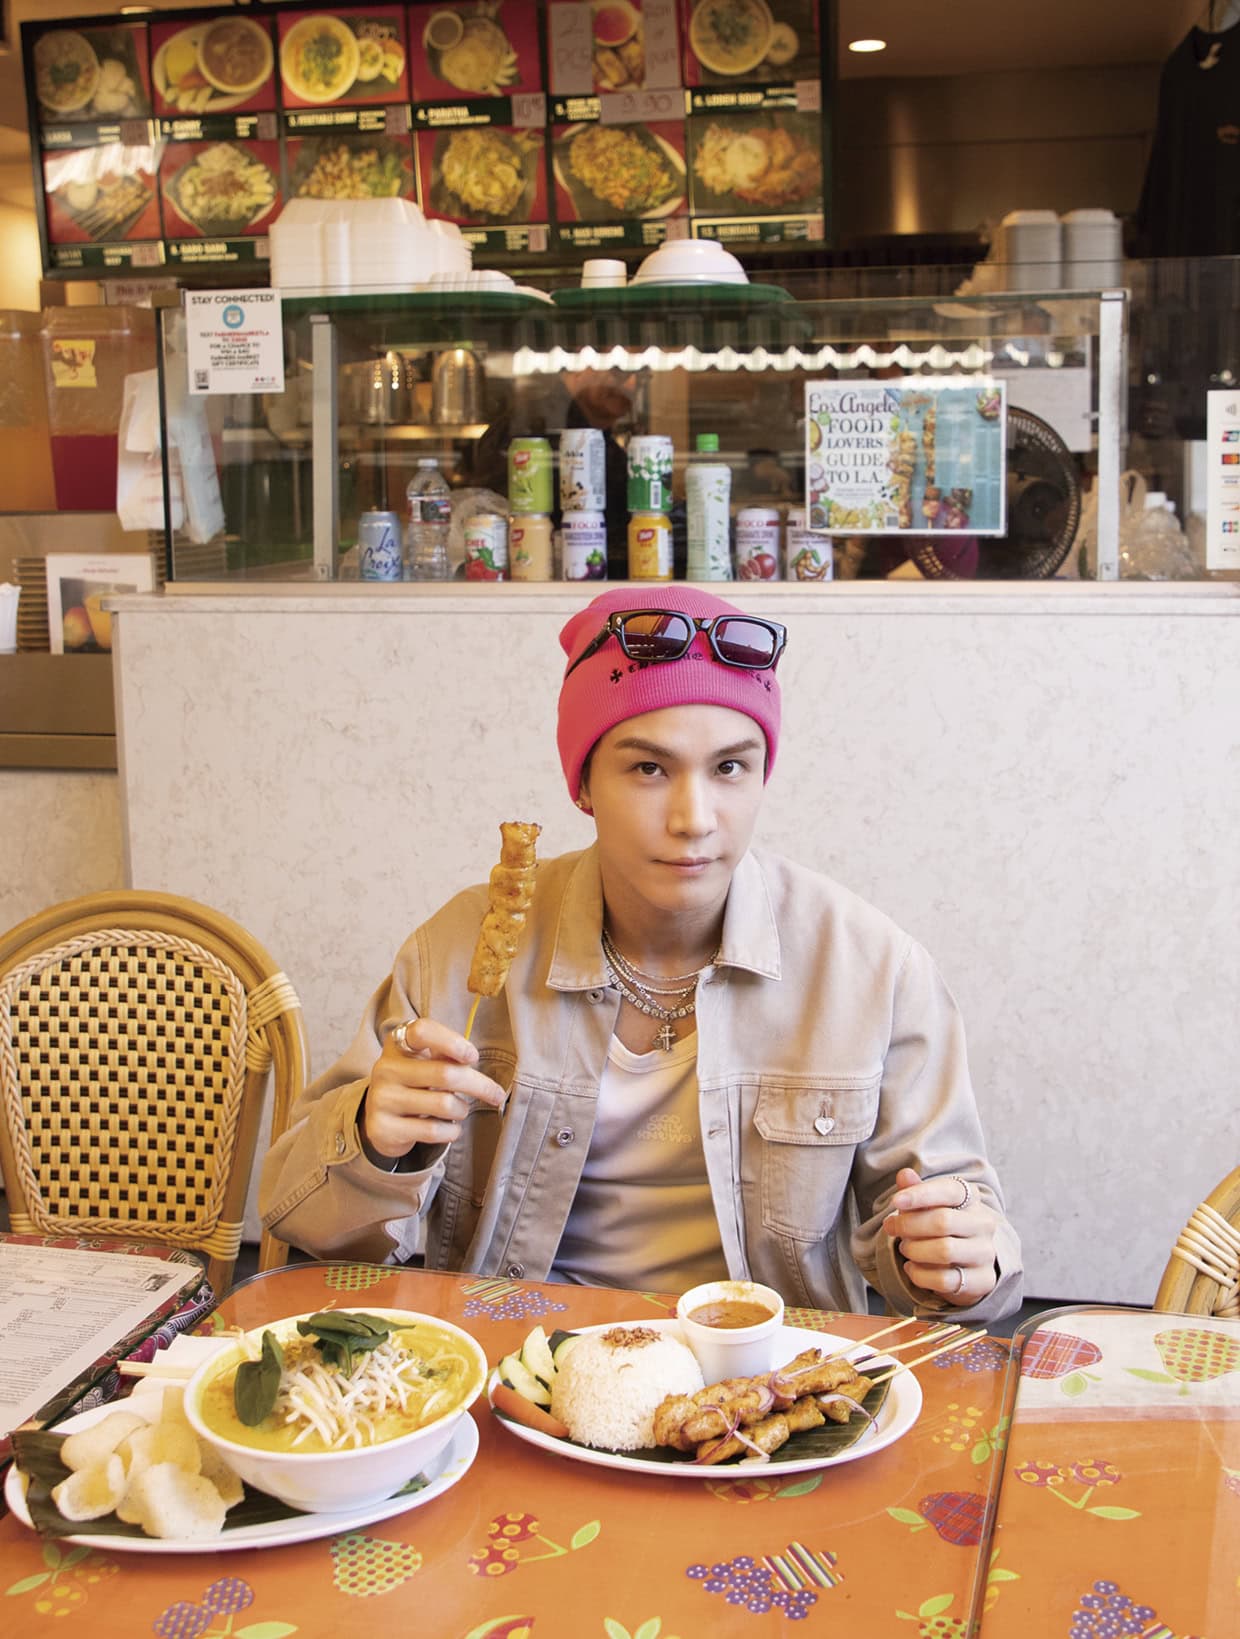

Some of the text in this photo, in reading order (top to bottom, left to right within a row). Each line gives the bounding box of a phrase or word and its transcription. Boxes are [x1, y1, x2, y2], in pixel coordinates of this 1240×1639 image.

[192, 294, 275, 305] STAY CONNECTED!
[809, 392, 839, 414] Los
[828, 418, 884, 434] FOOD
[827, 437, 884, 449] LOVERS
[826, 453, 884, 467] GUIDE
[827, 470, 884, 485] TO L.A.
